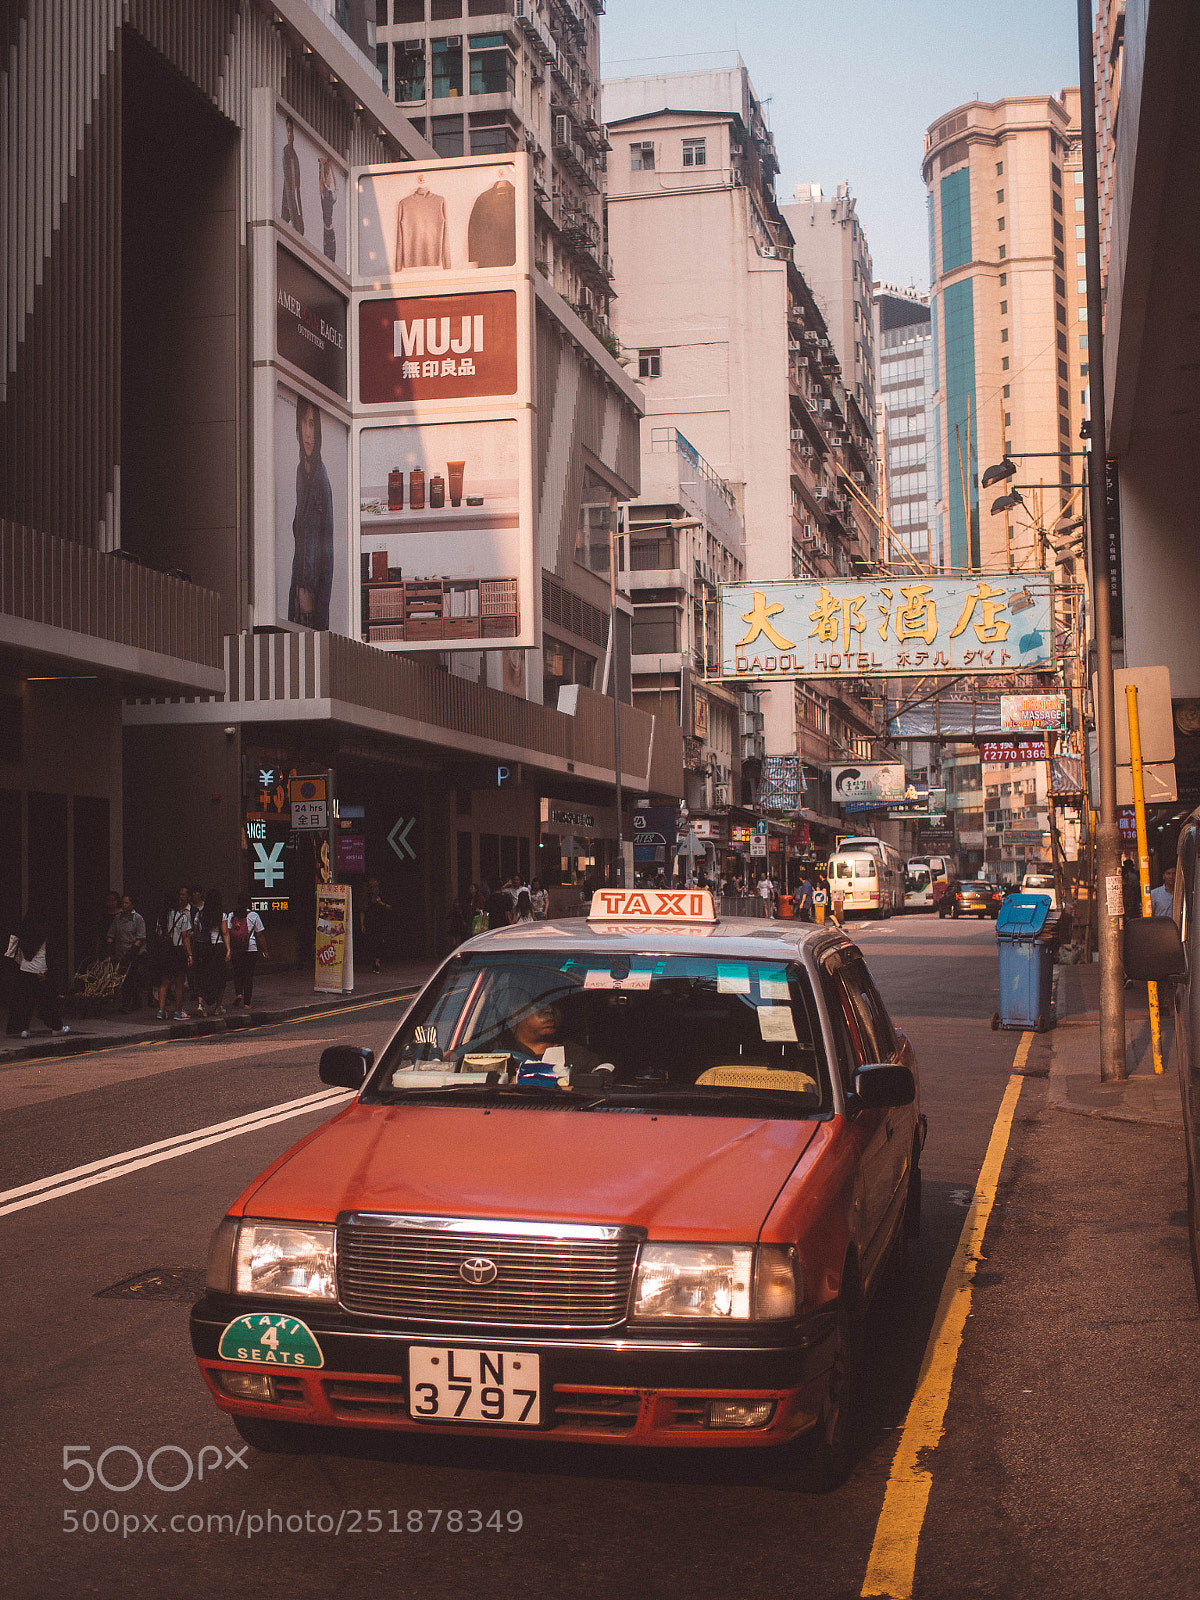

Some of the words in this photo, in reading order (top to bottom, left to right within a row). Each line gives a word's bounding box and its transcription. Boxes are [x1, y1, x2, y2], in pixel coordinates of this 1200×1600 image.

[277, 288, 320, 331] AMERICAN
[320, 319, 344, 350] EAGLE
[296, 323, 325, 351] OUTFITTERS
[392, 315, 484, 358] MUJI
[401, 357, 476, 379] 無印良品
[735, 581, 1011, 653] 大都酒店
[735, 652, 805, 673] DADOL
[814, 651, 883, 670] HOTEL
[896, 649, 949, 667] ホテル
[1021, 709, 1062, 720] MASSAGE
[497, 766, 510, 787] P
[295, 804, 306, 812] 24
[309, 804, 323, 812] hrs
[298, 814, 319, 826] 全日
[600, 892, 703, 916] TAXI
[319, 946, 335, 963] 108
[241, 1314, 300, 1336] TAXI
[260, 1325, 280, 1350] 4
[236, 1346, 306, 1365] SEATS
[447, 1350, 505, 1385] LN
[414, 1382, 538, 1422] 3797
